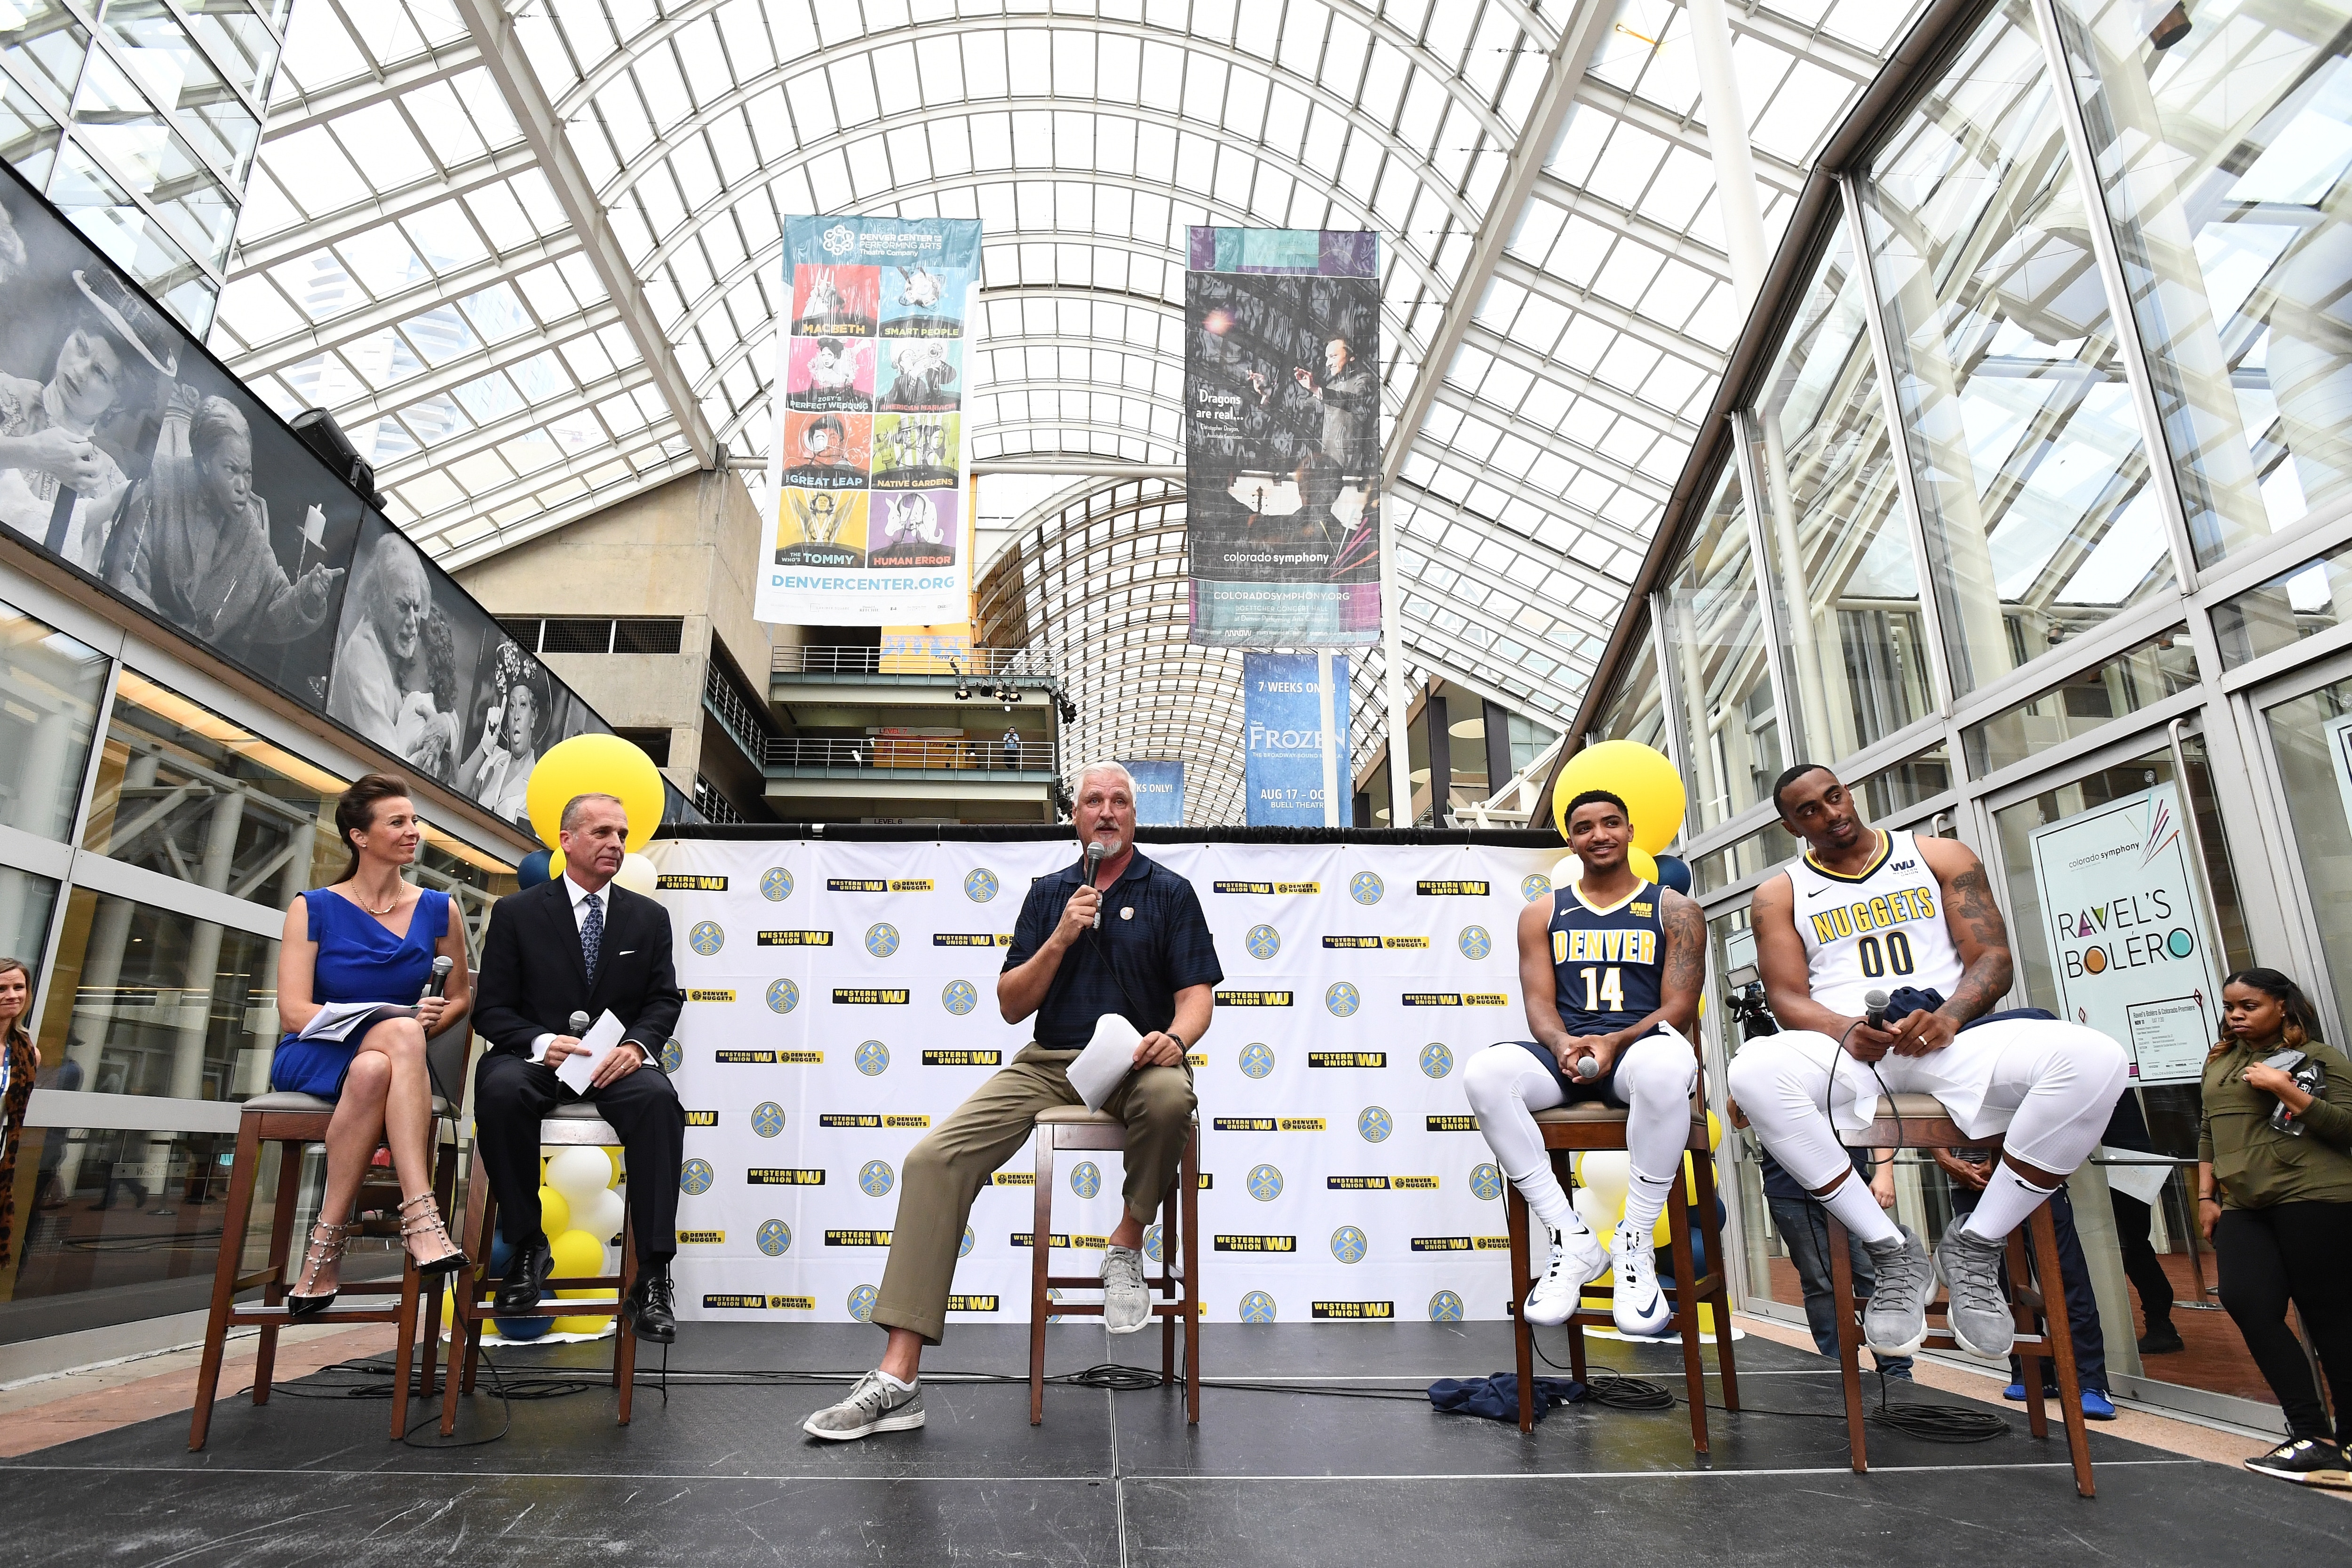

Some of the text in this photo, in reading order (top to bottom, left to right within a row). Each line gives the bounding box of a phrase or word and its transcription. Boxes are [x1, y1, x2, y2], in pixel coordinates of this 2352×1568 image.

[803, 324, 865, 334] MACBETH
[1200, 389, 1240, 407] Dragons
[790, 401, 869, 410] PERFECT WEDDING
[1196, 406, 1244, 420] are real...
[1200, 423, 1223, 432] Christopher
[790, 475, 830, 486] GREAT
[833, 477, 862, 486] LEAP
[912, 478, 953, 487] GARDENS
[803, 553, 855, 565] TOMMY
[915, 556, 951, 564] ERROR
[1224, 552, 1329, 564] colorado symphony
[771, 575, 954, 591] DENVERCENTER.ORG
[1214, 591, 1350, 601] COLORADOSYMPHONY.ORG
[1258, 681, 1335, 693] 7 WEEKS ON!
[1149, 784, 1173, 793] ONLY!
[1261, 789, 1282, 800] AUG
[1286, 789, 1298, 799] 17
[2069, 854, 2099, 868] colorado
[2101, 842, 2139, 859] symphony
[865, 881, 883, 891] WU
[1251, 883, 1270, 894] WU
[1462, 882, 1486, 895] WU
[1630, 902, 1653, 912] WU
[1809, 887, 1937, 946] NUGGETS
[2058, 889, 2172, 941] RAVEL'S
[804, 932, 829, 945] WU
[1359, 937, 1378, 948] WU
[1552, 929, 1656, 965] DENVER
[2065, 927, 2194, 978] BOLÉRO
[1857, 930, 1915, 978] 00
[1581, 967, 1624, 1011] 14
[881, 990, 906, 1003] WU
[1264, 992, 1289, 1005] WU
[1438, 995, 1458, 1005] WU
[754, 1052, 772, 1062] WU
[1357, 1053, 1382, 1067] WU
[796, 1171, 821, 1184] WU
[1265, 1237, 1292, 1251] WU
[743, 1297, 762, 1307] WU
[1364, 1303, 1390, 1317] WU
